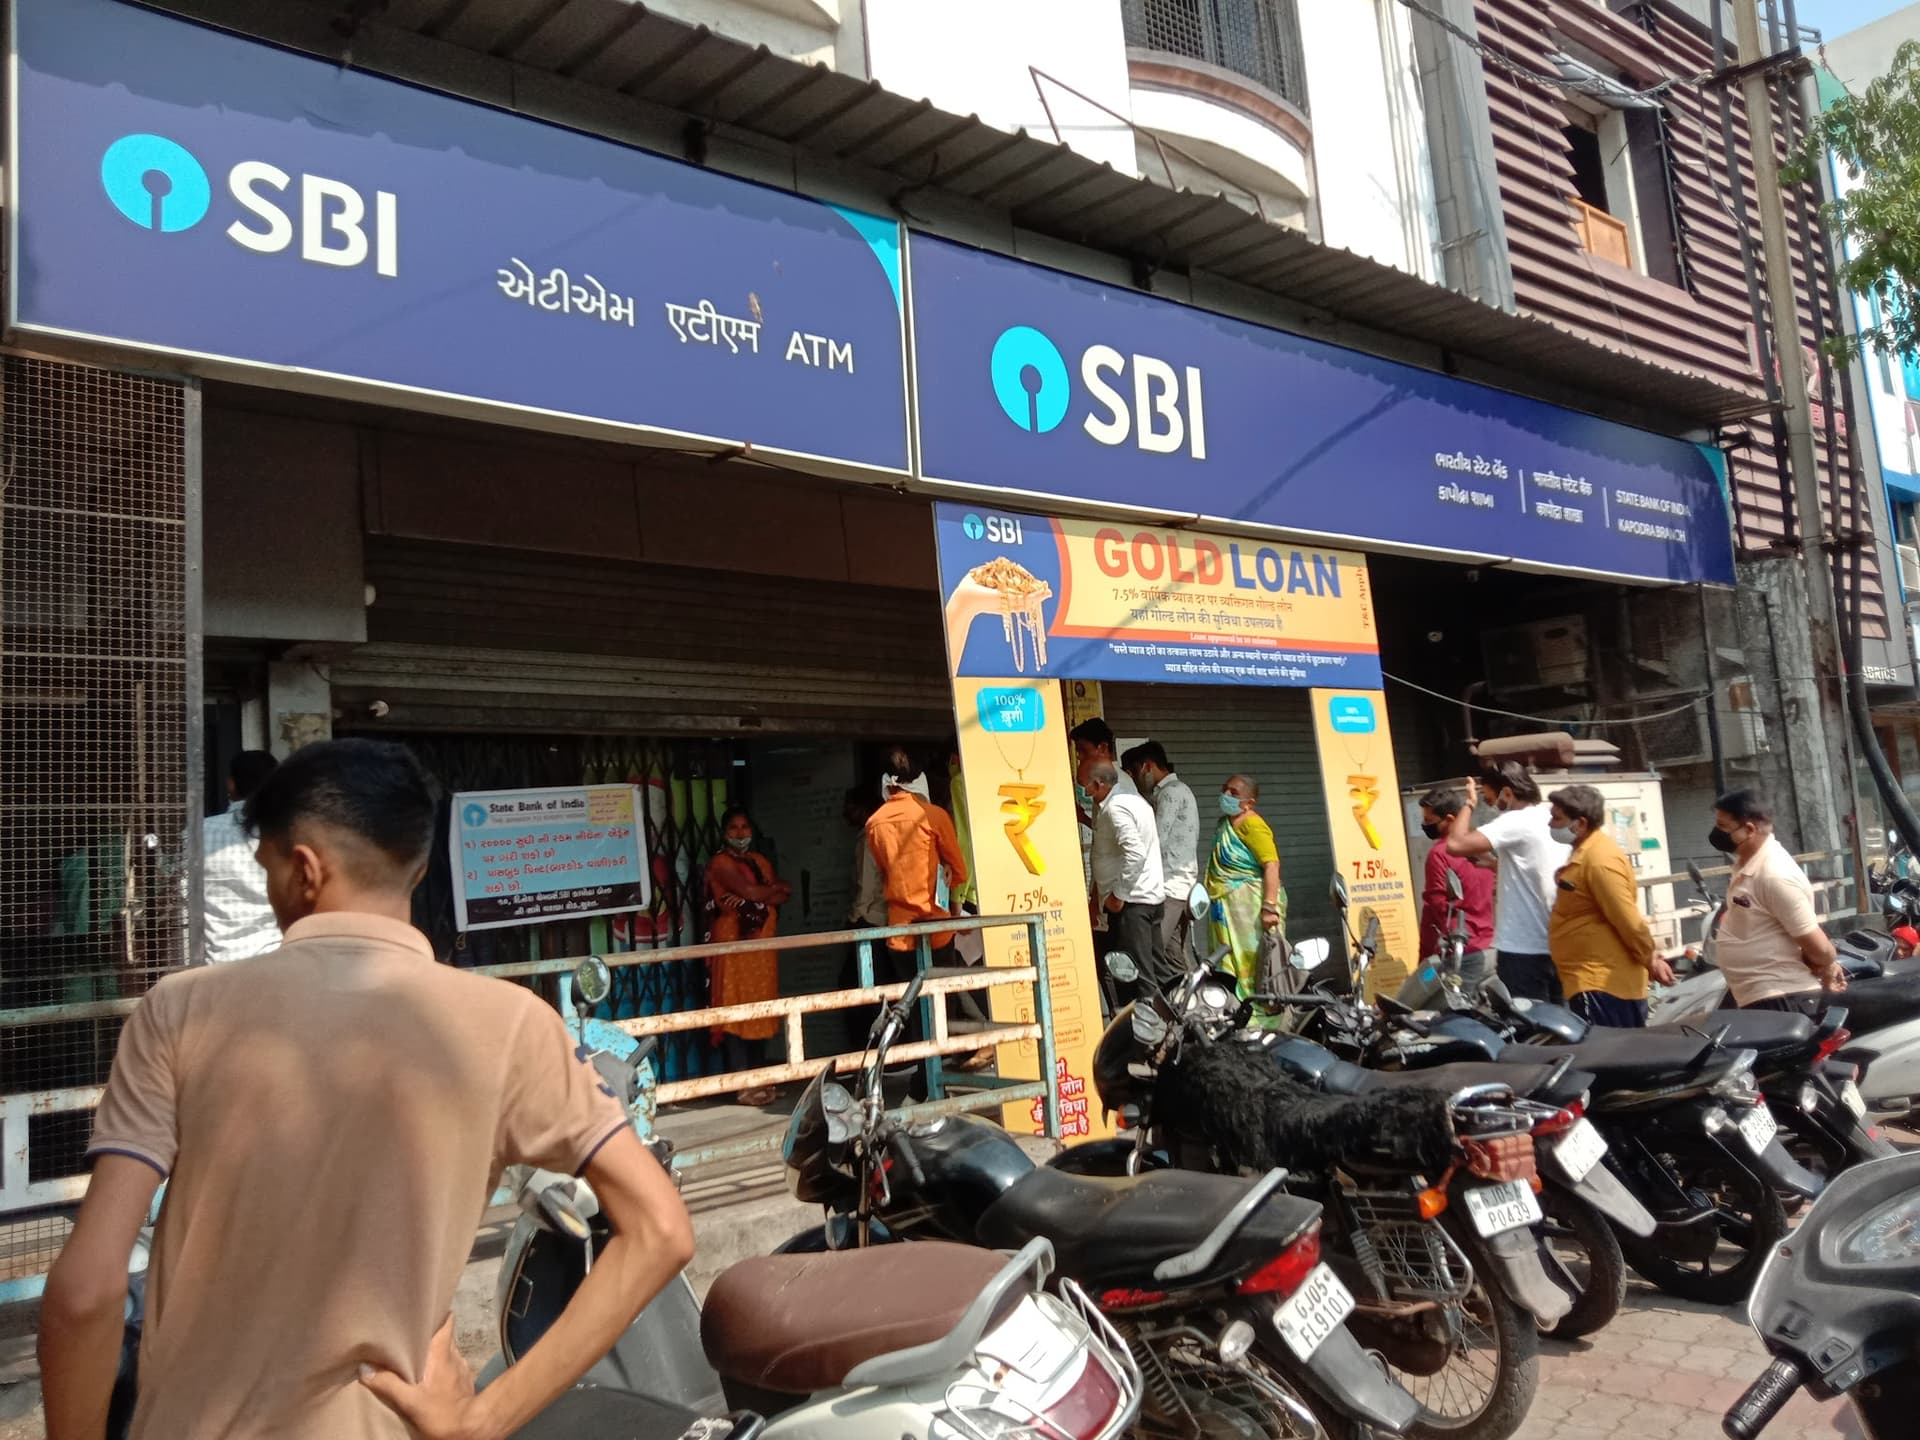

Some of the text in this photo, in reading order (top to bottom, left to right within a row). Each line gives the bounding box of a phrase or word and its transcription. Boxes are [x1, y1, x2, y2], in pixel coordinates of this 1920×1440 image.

[226, 160, 398, 278] SBI
[497, 257, 635, 327] એટીએમ
[665, 299, 761, 353] एटीएम
[785, 330, 854, 374] ATM
[1080, 343, 1207, 459] SBI
[1615, 489, 1640, 507] STATE
[1640, 494, 1660, 511] BANK
[1660, 499, 1671, 512] OF
[986, 515, 1023, 545] SBI
[1094, 528, 1342, 598] GOLD LOAN
[1112, 588, 1139, 601] 7.5%
[994, 693, 1026, 706] 100%
[489, 798, 585, 813] State Bank of India
[1352, 860, 1389, 879] 7.5%
[1007, 886, 1048, 913] 7.5%
[1294, 1276, 1328, 1320] GJ05
[1299, 1288, 1351, 1349] FL9101
